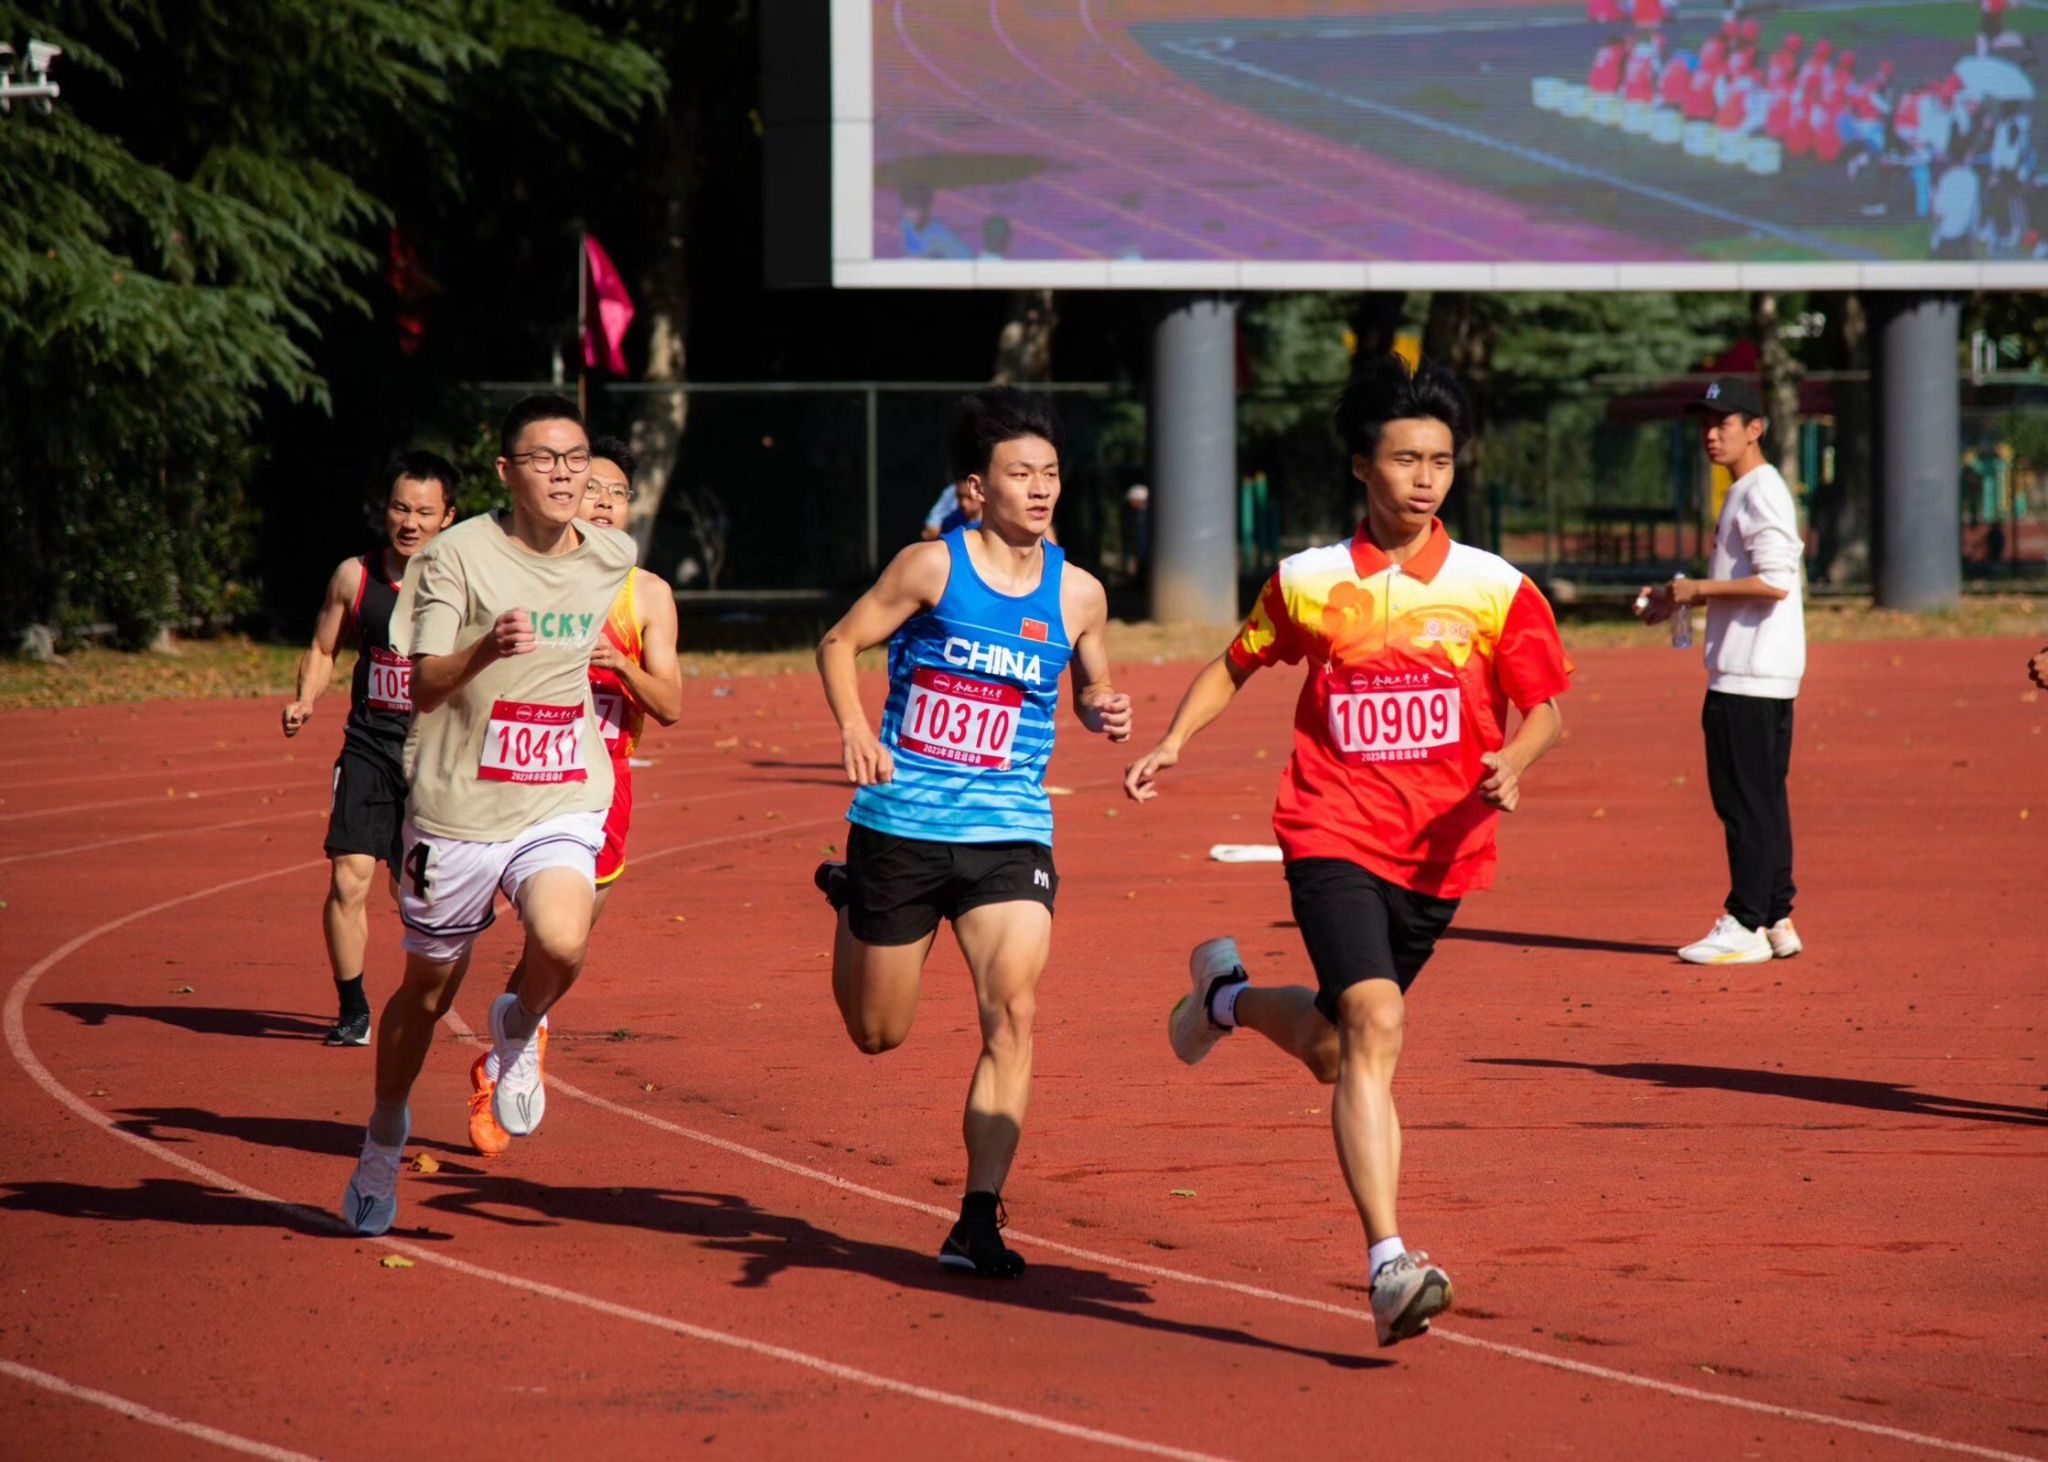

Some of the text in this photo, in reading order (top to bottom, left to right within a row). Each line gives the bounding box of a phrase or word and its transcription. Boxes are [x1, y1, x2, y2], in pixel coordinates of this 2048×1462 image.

[943, 636, 1041, 686] CHINA
[913, 693, 1010, 751] 10310
[1337, 693, 1449, 746] 10909
